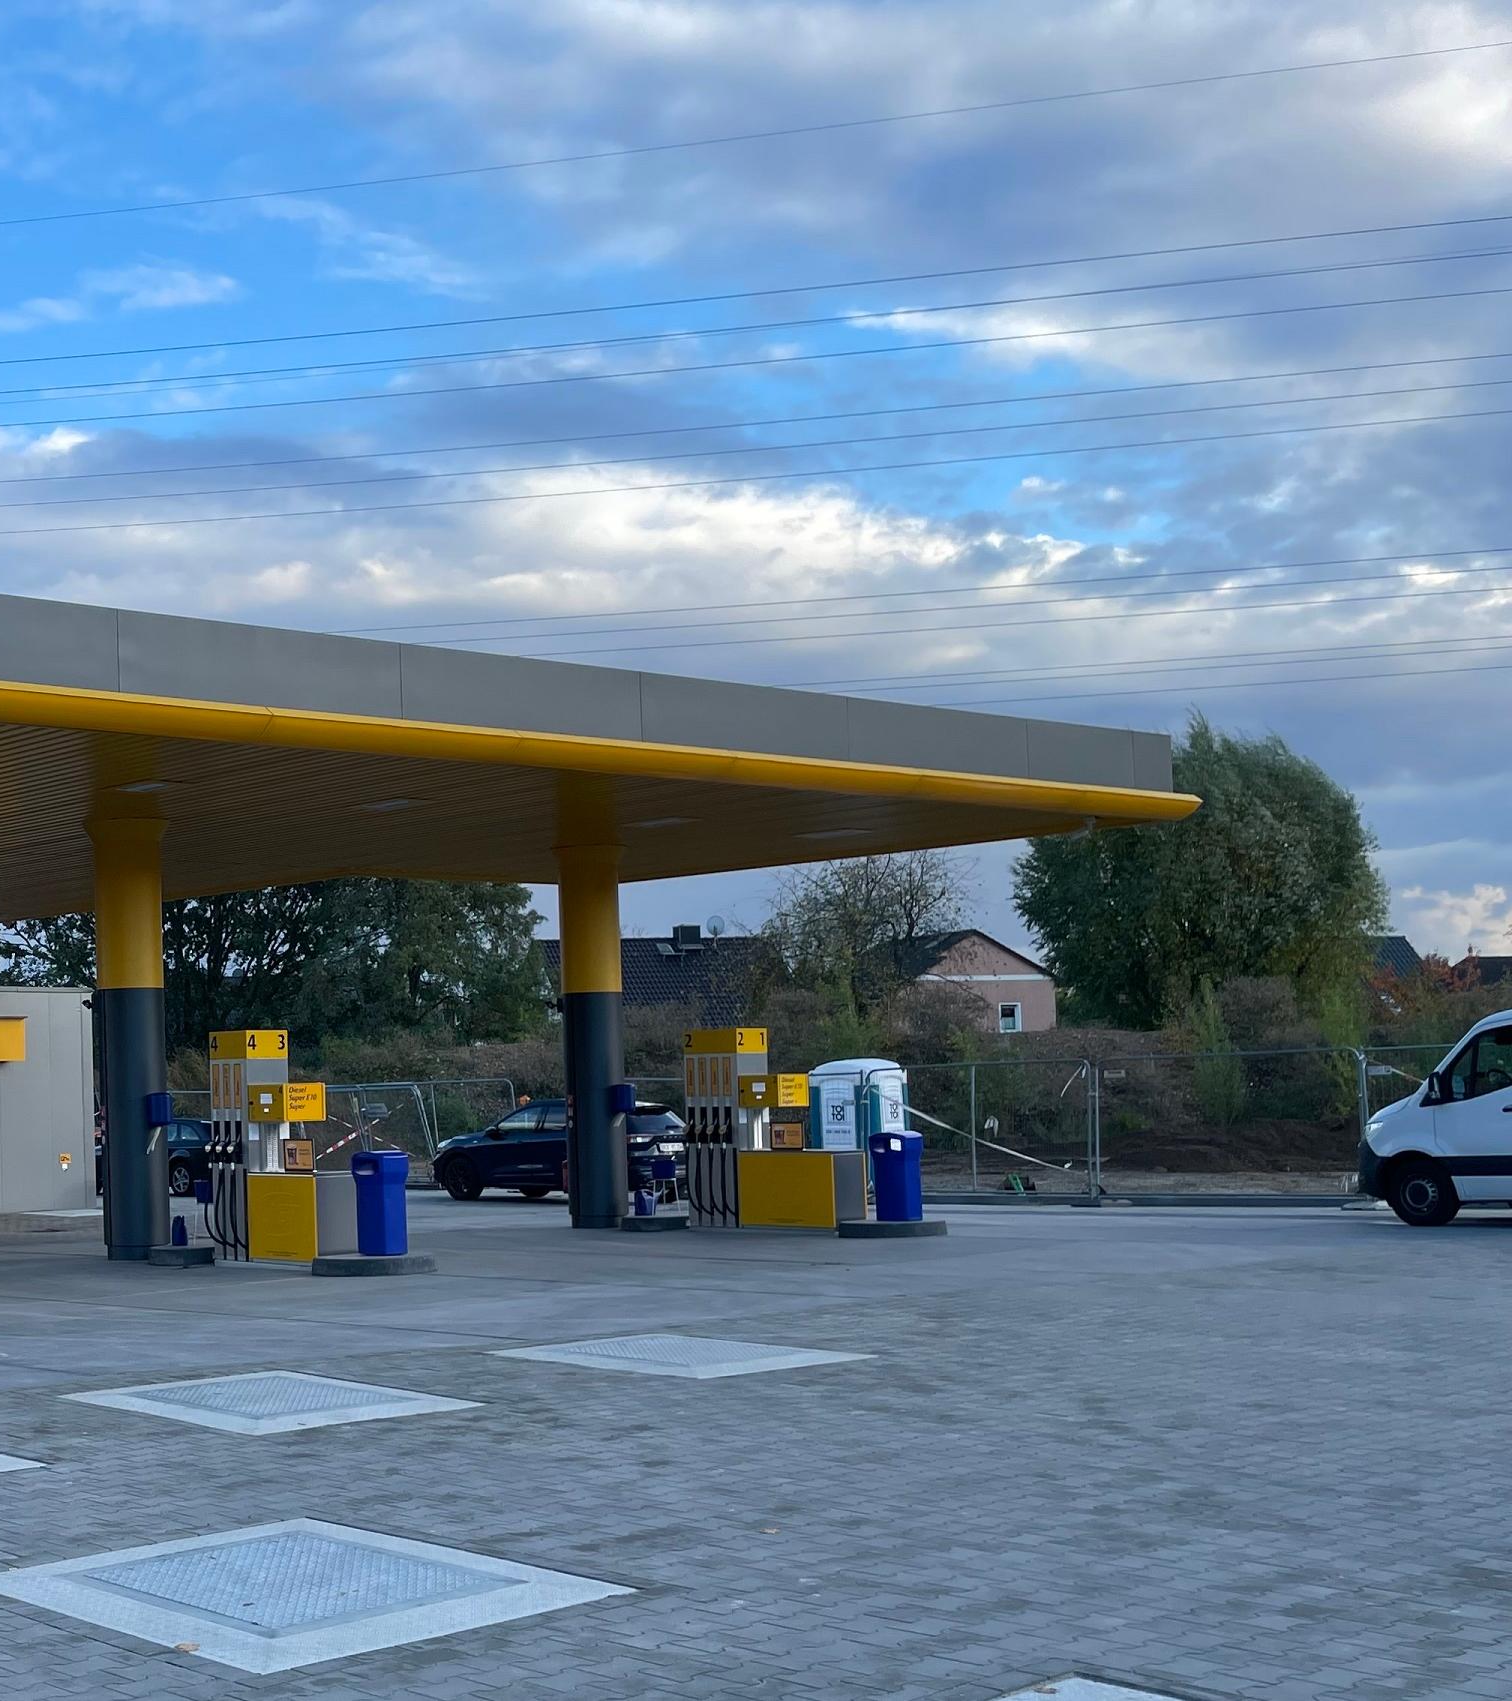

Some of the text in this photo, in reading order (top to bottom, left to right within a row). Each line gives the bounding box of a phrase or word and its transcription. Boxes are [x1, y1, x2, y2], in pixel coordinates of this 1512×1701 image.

[210, 1036, 218, 1052] 4
[248, 1034, 256, 1050] 4
[278, 1034, 285, 1050] 3
[684, 1034, 693, 1048] 2
[738, 1032, 744, 1046] 2
[760, 1032, 765, 1046] 1
[289, 1086, 307, 1094] Diesel
[288, 1094, 306, 1103] Super
[831, 1105, 845, 1113] TOI
[832, 1113, 845, 1121] TOI
